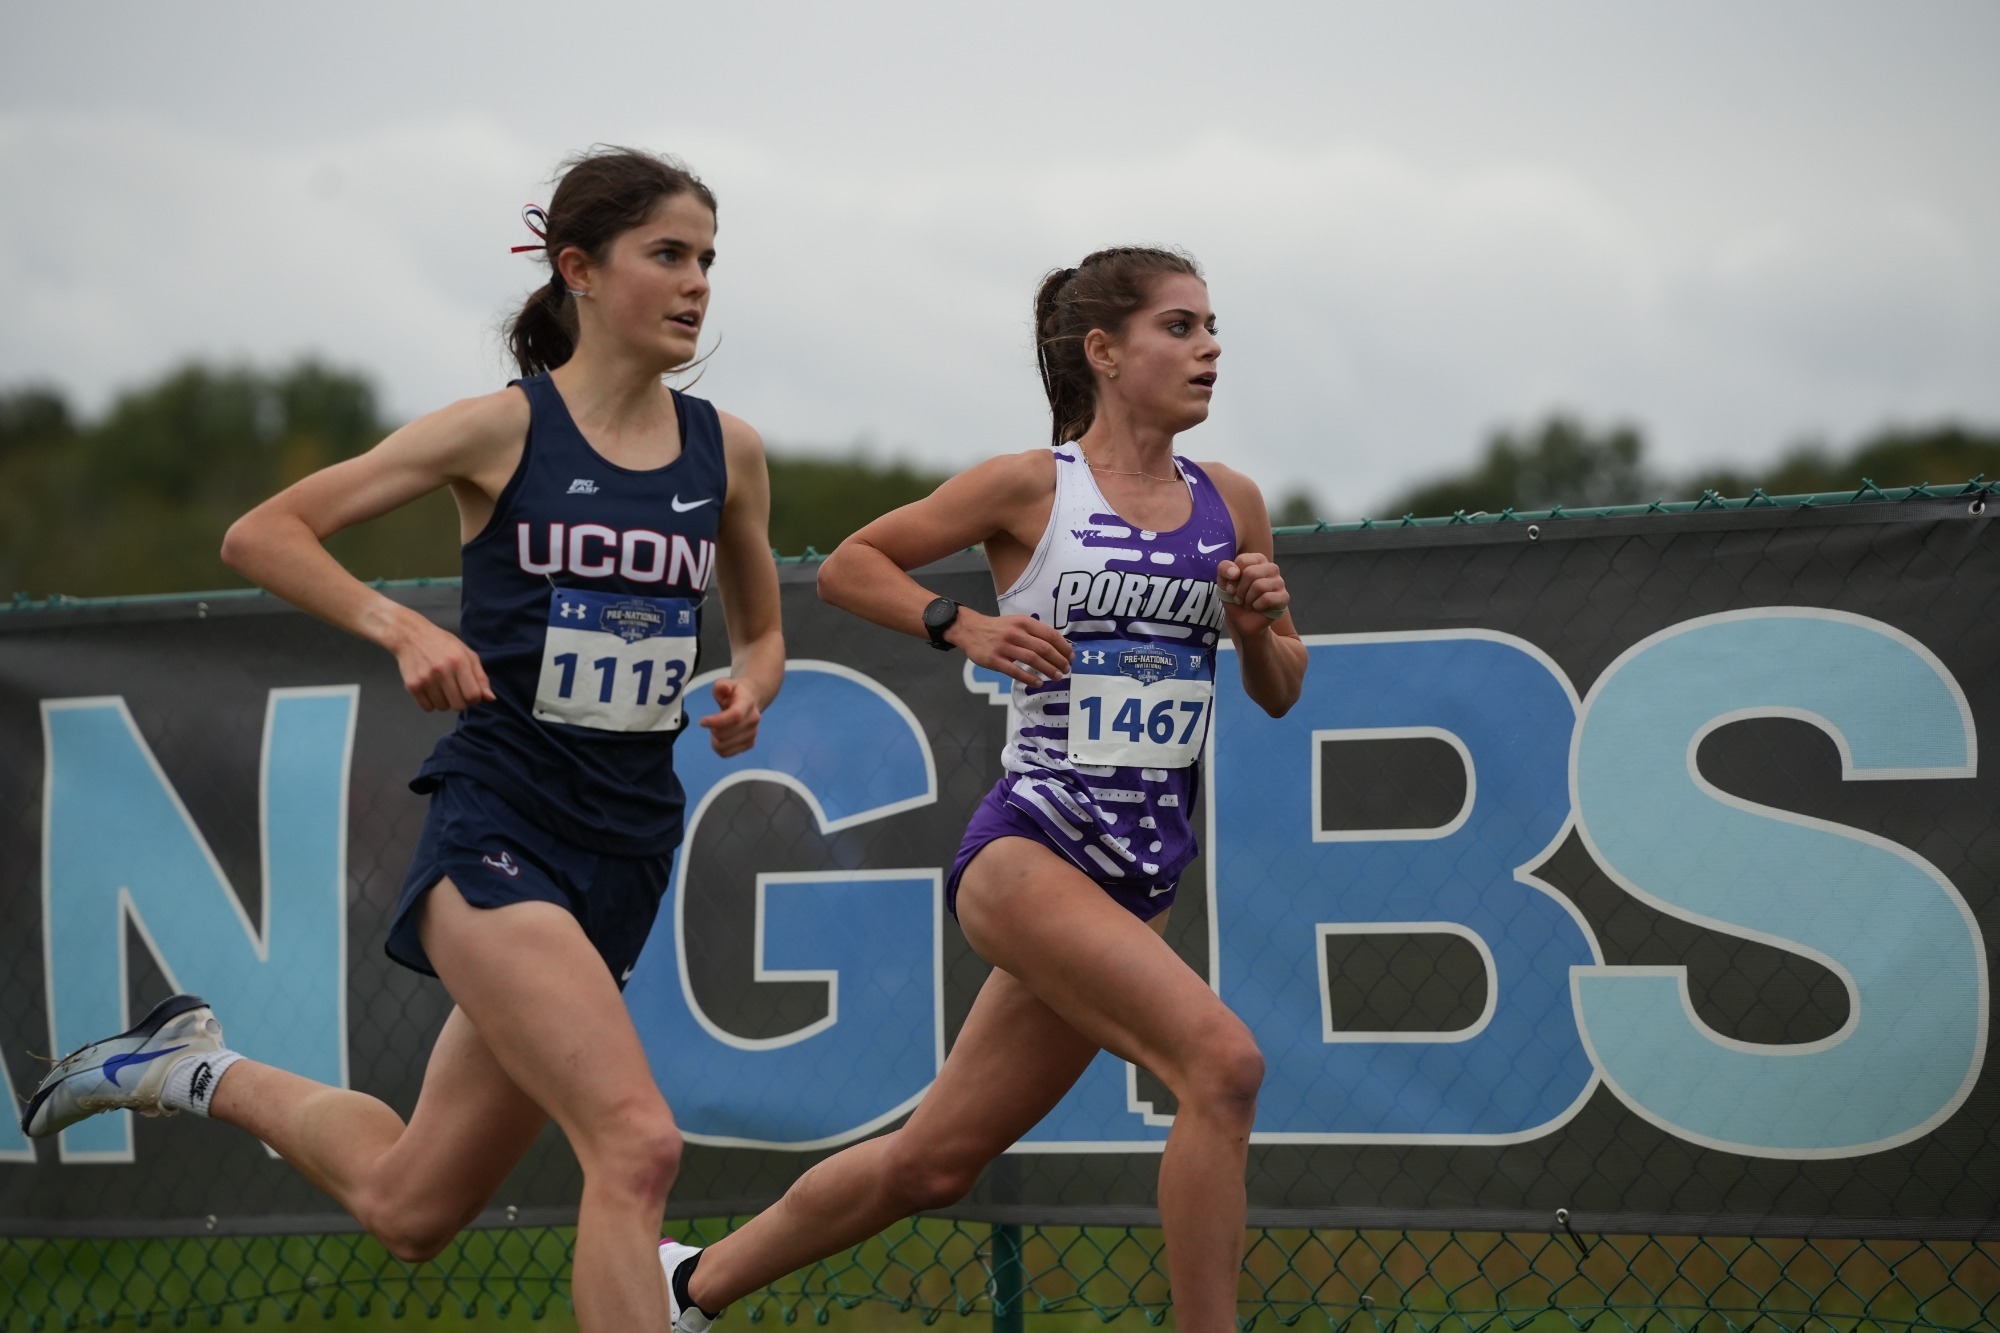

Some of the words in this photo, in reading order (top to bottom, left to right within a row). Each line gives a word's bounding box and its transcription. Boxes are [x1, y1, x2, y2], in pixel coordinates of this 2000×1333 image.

[1070, 529, 1102, 540] WCC
[516, 522, 716, 592] UCON
[1054, 569, 1226, 631] PORTLAN
[607, 610, 660, 623] PRE-NATIONAL
[1124, 655, 1173, 666] PRE-NATIONAL
[1134, 662, 1162, 670] INVITATIONAL
[553, 652, 687, 706] 1113
[1079, 696, 1204, 745] 1467
